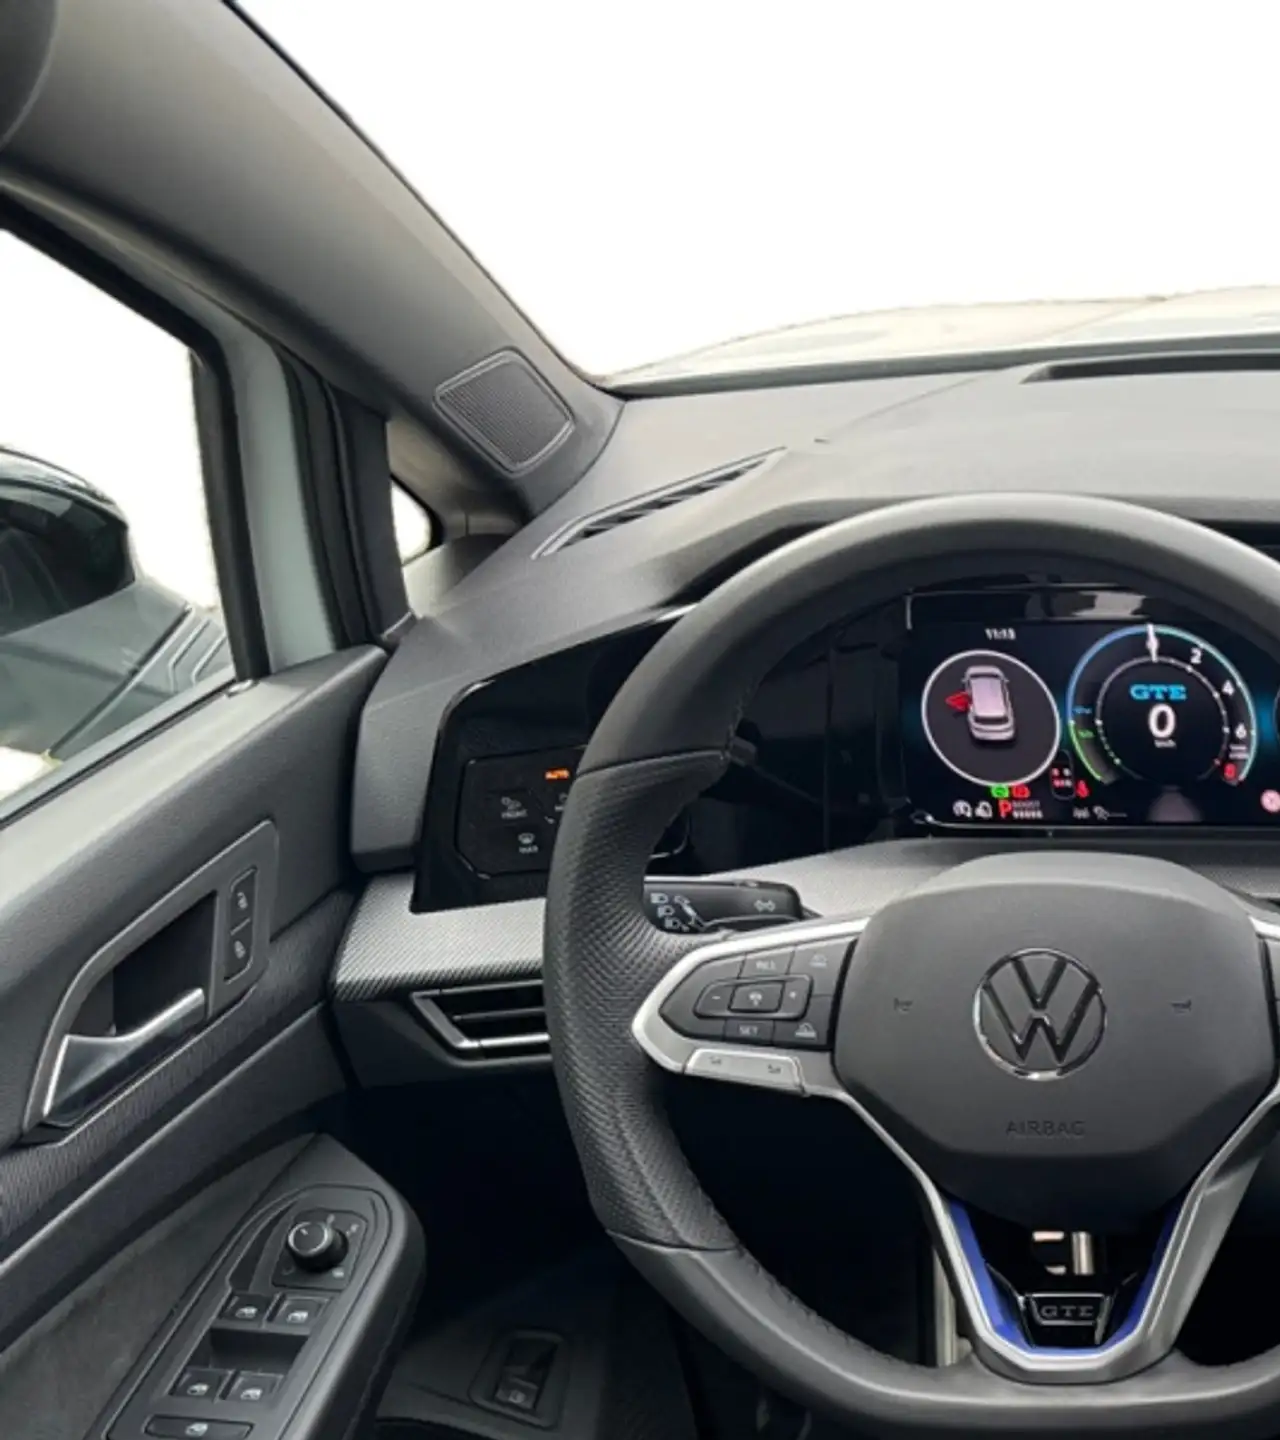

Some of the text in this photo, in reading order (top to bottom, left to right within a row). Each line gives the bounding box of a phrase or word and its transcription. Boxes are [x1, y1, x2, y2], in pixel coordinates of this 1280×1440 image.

[1190, 648, 1203, 664] 2
[1129, 683, 1188, 701] GTE
[1222, 679, 1236, 696] 4
[1148, 703, 1176, 739] 0
[1235, 723, 1248, 740] 6
[998, 800, 1012, 819] P
[1005, 1120, 1086, 1137] AIRBAG
[1041, 1305, 1094, 1318] GTE
